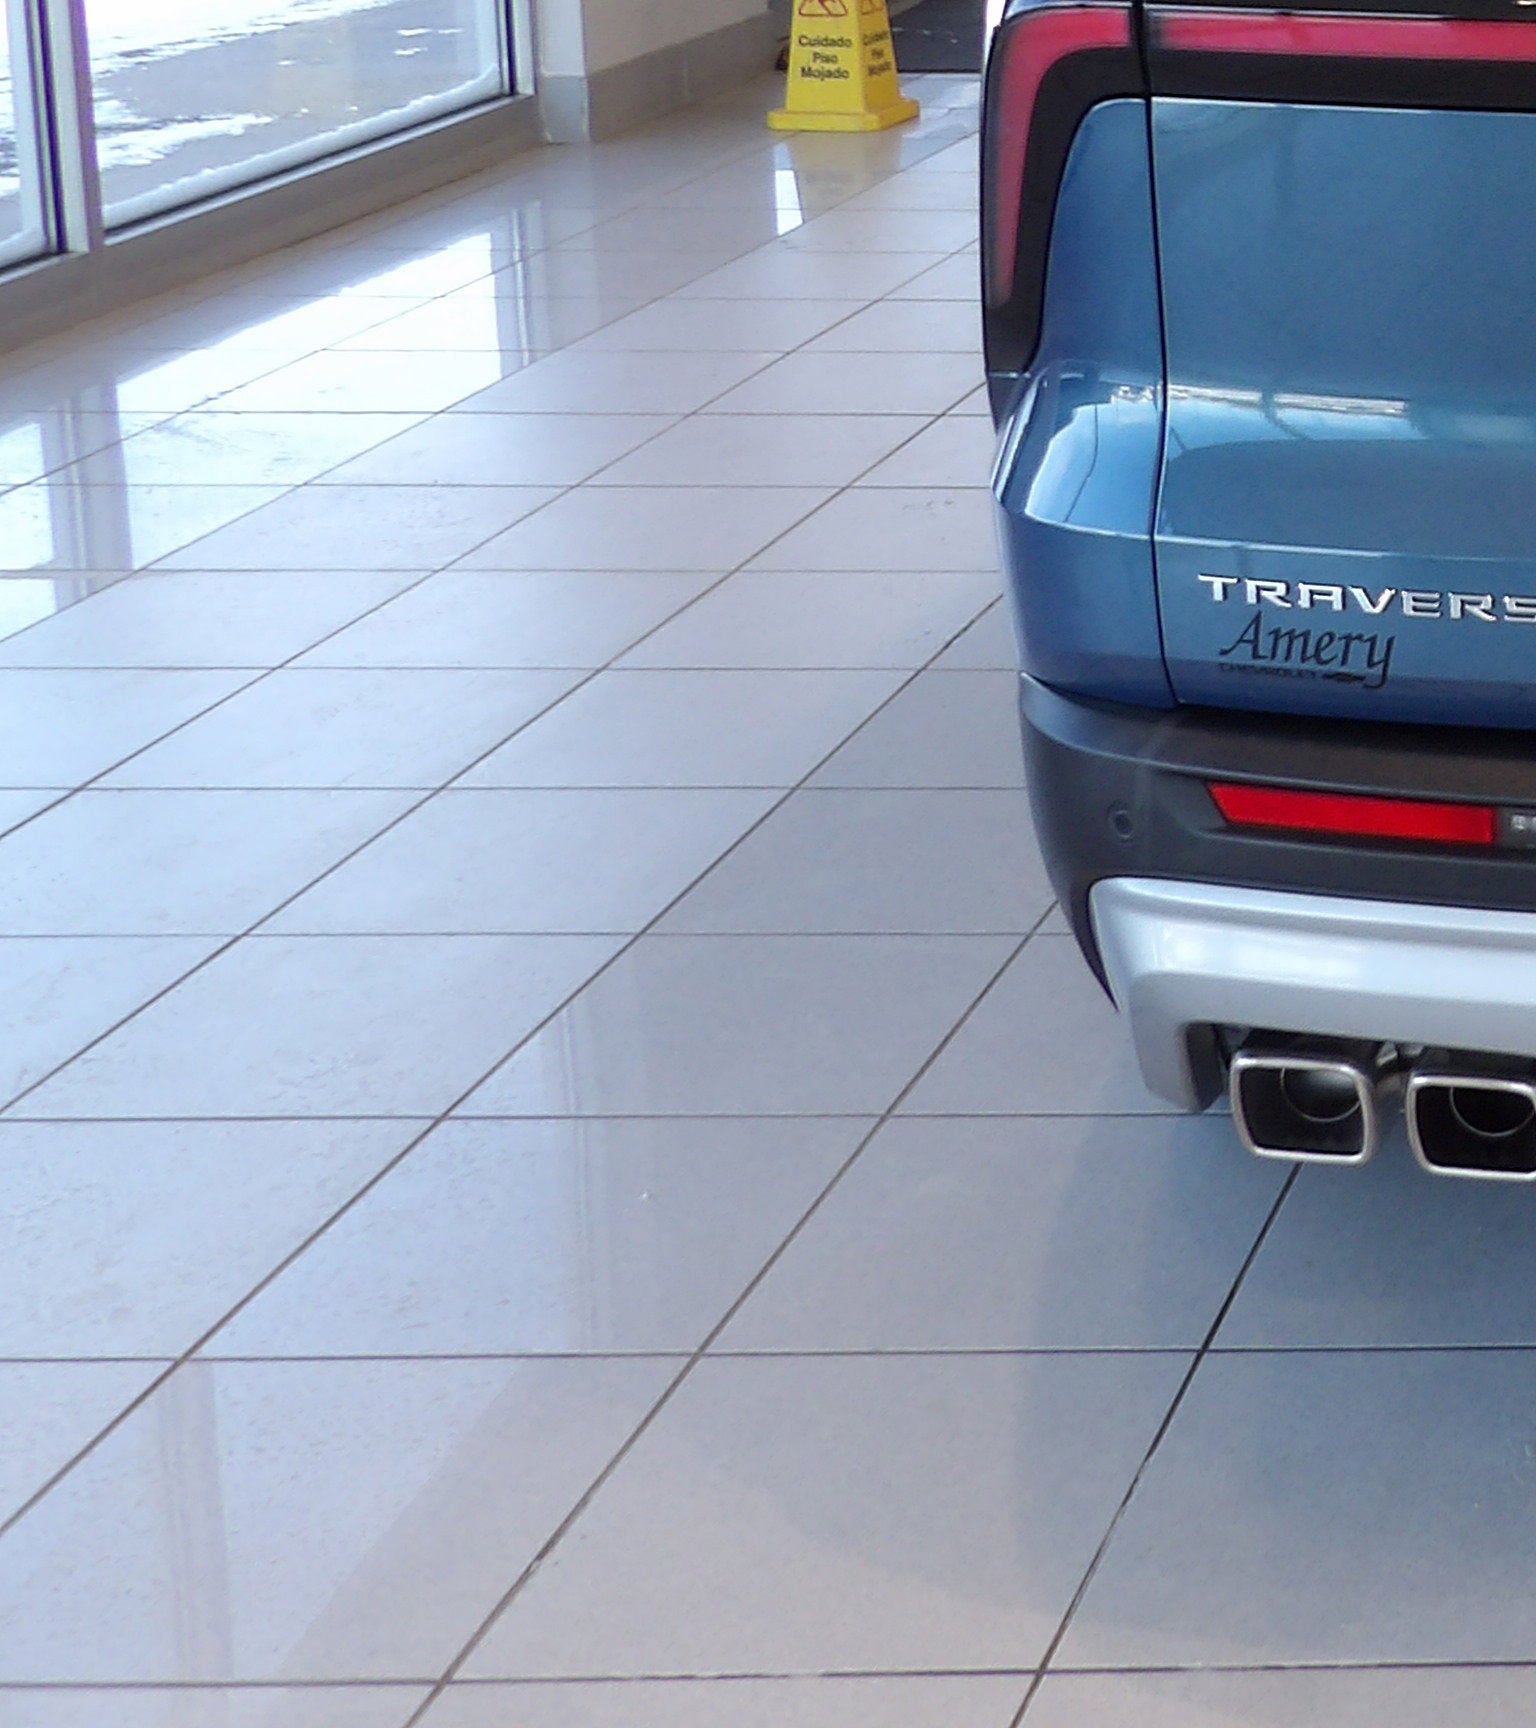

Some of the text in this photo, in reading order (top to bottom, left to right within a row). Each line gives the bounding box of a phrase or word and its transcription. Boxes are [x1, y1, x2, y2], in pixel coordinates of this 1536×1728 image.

[798, 34, 853, 47] Cuidado
[812, 52, 839, 64] Piso
[801, 66, 850, 81] Mojado
[1218, 609, 1396, 690] Amery
